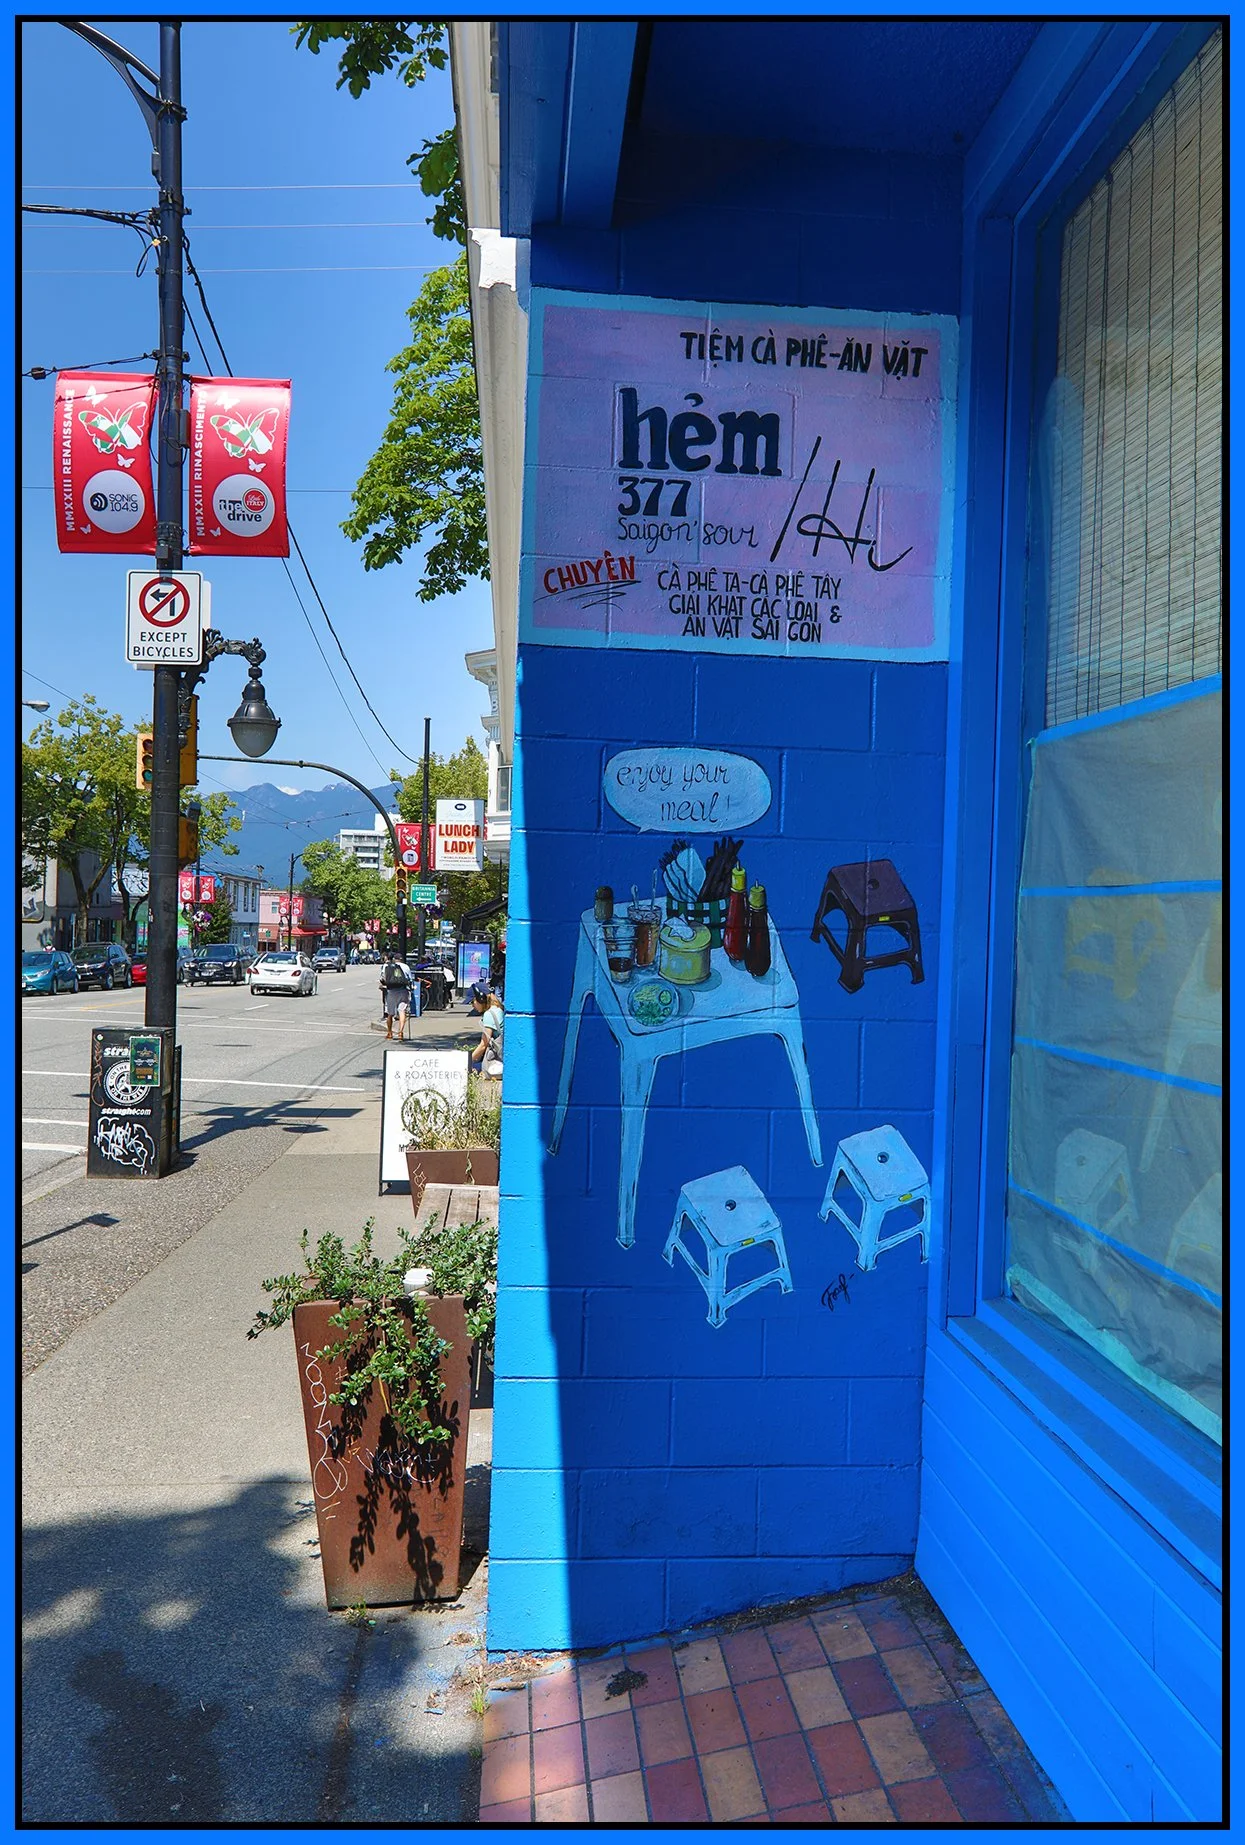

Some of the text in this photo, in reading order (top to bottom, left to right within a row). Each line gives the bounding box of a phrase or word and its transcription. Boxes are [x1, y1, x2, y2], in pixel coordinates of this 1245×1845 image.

[680, 328, 744, 368] TIỆM
[750, 329, 777, 365] CÀ
[618, 387, 783, 477] hẻm
[62, 388, 76, 533] MMXXIII RENAISSANCE
[110, 502, 139, 512] 104.9
[219, 499, 243, 511] the
[617, 476, 692, 518] 377
[194, 484, 206, 537] MMXXIII
[227, 510, 262, 522] drive
[543, 550, 635, 594] CHUYÊN
[657, 562, 681, 591] CÀ
[687, 567, 718, 592] PHÊ
[775, 570, 805, 598] PHÊ
[811, 573, 842, 600] TÂY
[829, 604, 842, 624] &
[140, 631, 187, 643] EXCEPT
[133, 646, 194, 658] BICYCLES
[616, 763, 730, 792] enjoy your
[438, 824, 480, 837] LUNCH
[443, 840, 474, 853] LADY
[394, 1070, 463, 1080] & ROASTERIE
